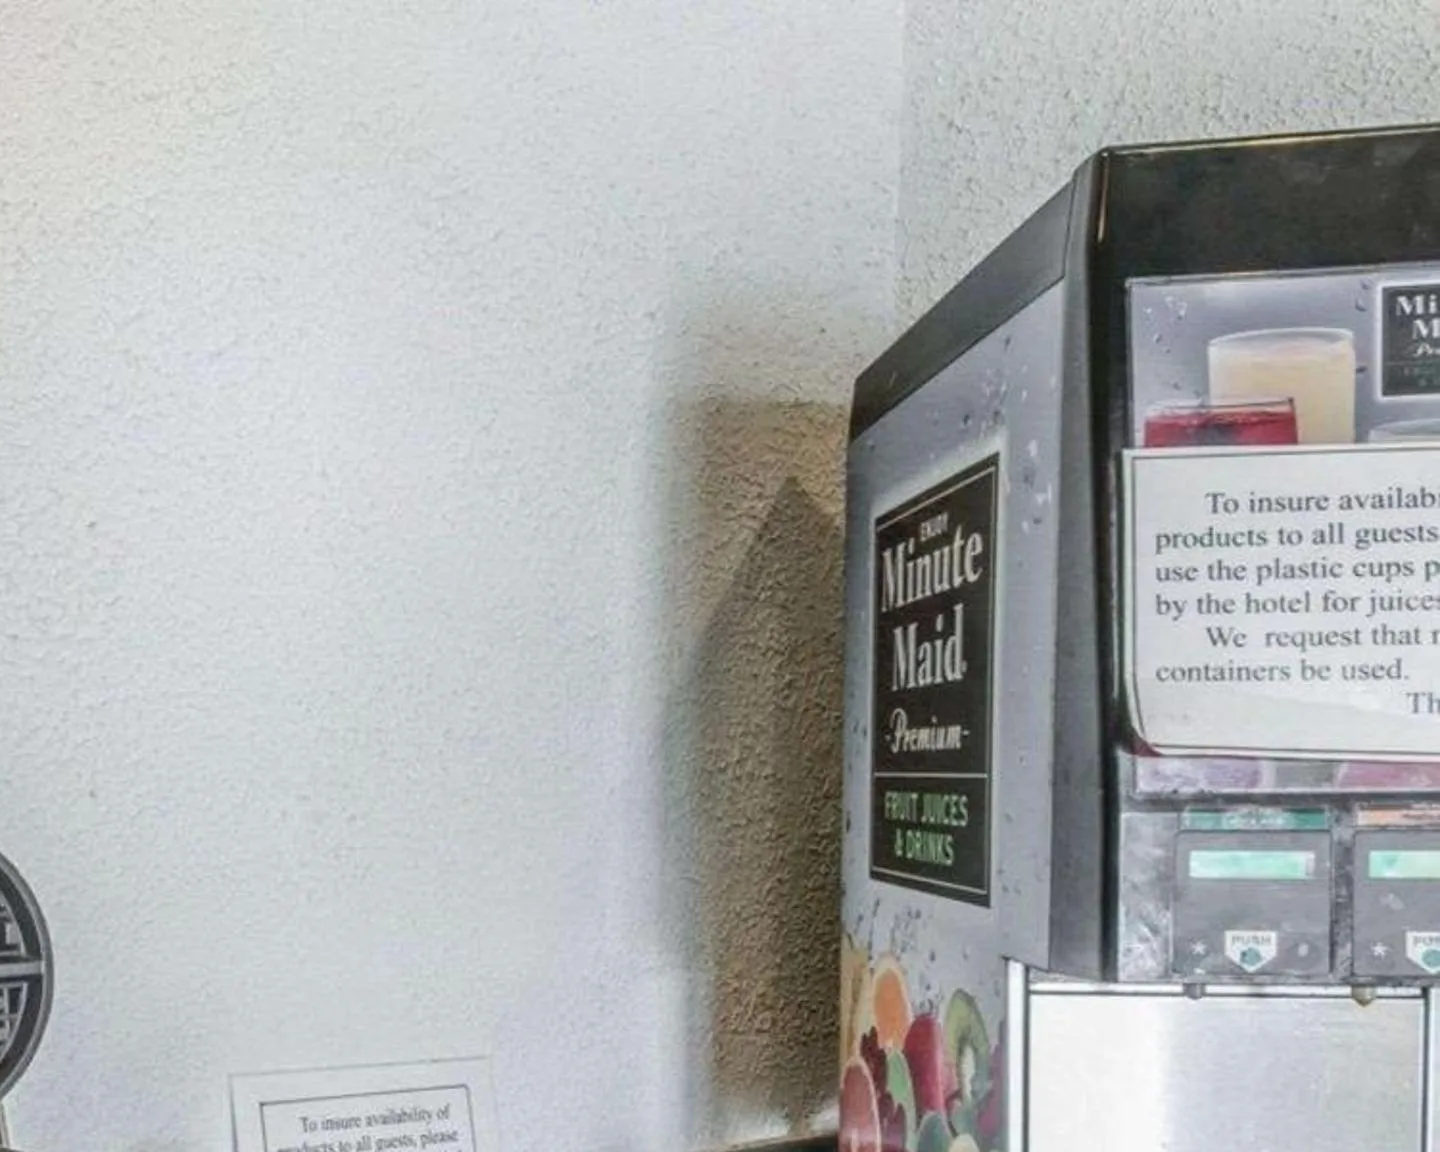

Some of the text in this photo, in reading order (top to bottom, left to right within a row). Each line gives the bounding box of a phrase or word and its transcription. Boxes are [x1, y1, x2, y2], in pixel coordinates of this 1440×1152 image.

[1205, 492, 1239, 514] To
[1248, 491, 1329, 513] insure
[1155, 522, 1440, 554] products to all guests
[881, 524, 984, 613] Minute
[1155, 565, 1199, 582] use
[1207, 559, 1247, 581] the
[1256, 557, 1343, 585] plastic
[1352, 560, 1415, 584] cups
[1155, 594, 1188, 621] by
[1196, 591, 1236, 615] the
[1245, 591, 1311, 615] hotel
[1322, 590, 1362, 613] for
[891, 603, 965, 692] Maid
[1206, 627, 1248, 649] We
[1265, 625, 1362, 652] request
[1371, 623, 1422, 646] that
[1155, 657, 1410, 683] containers be used.
[884, 791, 969, 827] FRUIT JUICES
[906, 829, 954, 866] DRINKS
[298, 1116, 318, 1132] To
[436, 1102, 451, 1120] of
[339, 1140, 352, 1152] to
[356, 1135, 372, 1152] all
[420, 1129, 459, 1150] please
